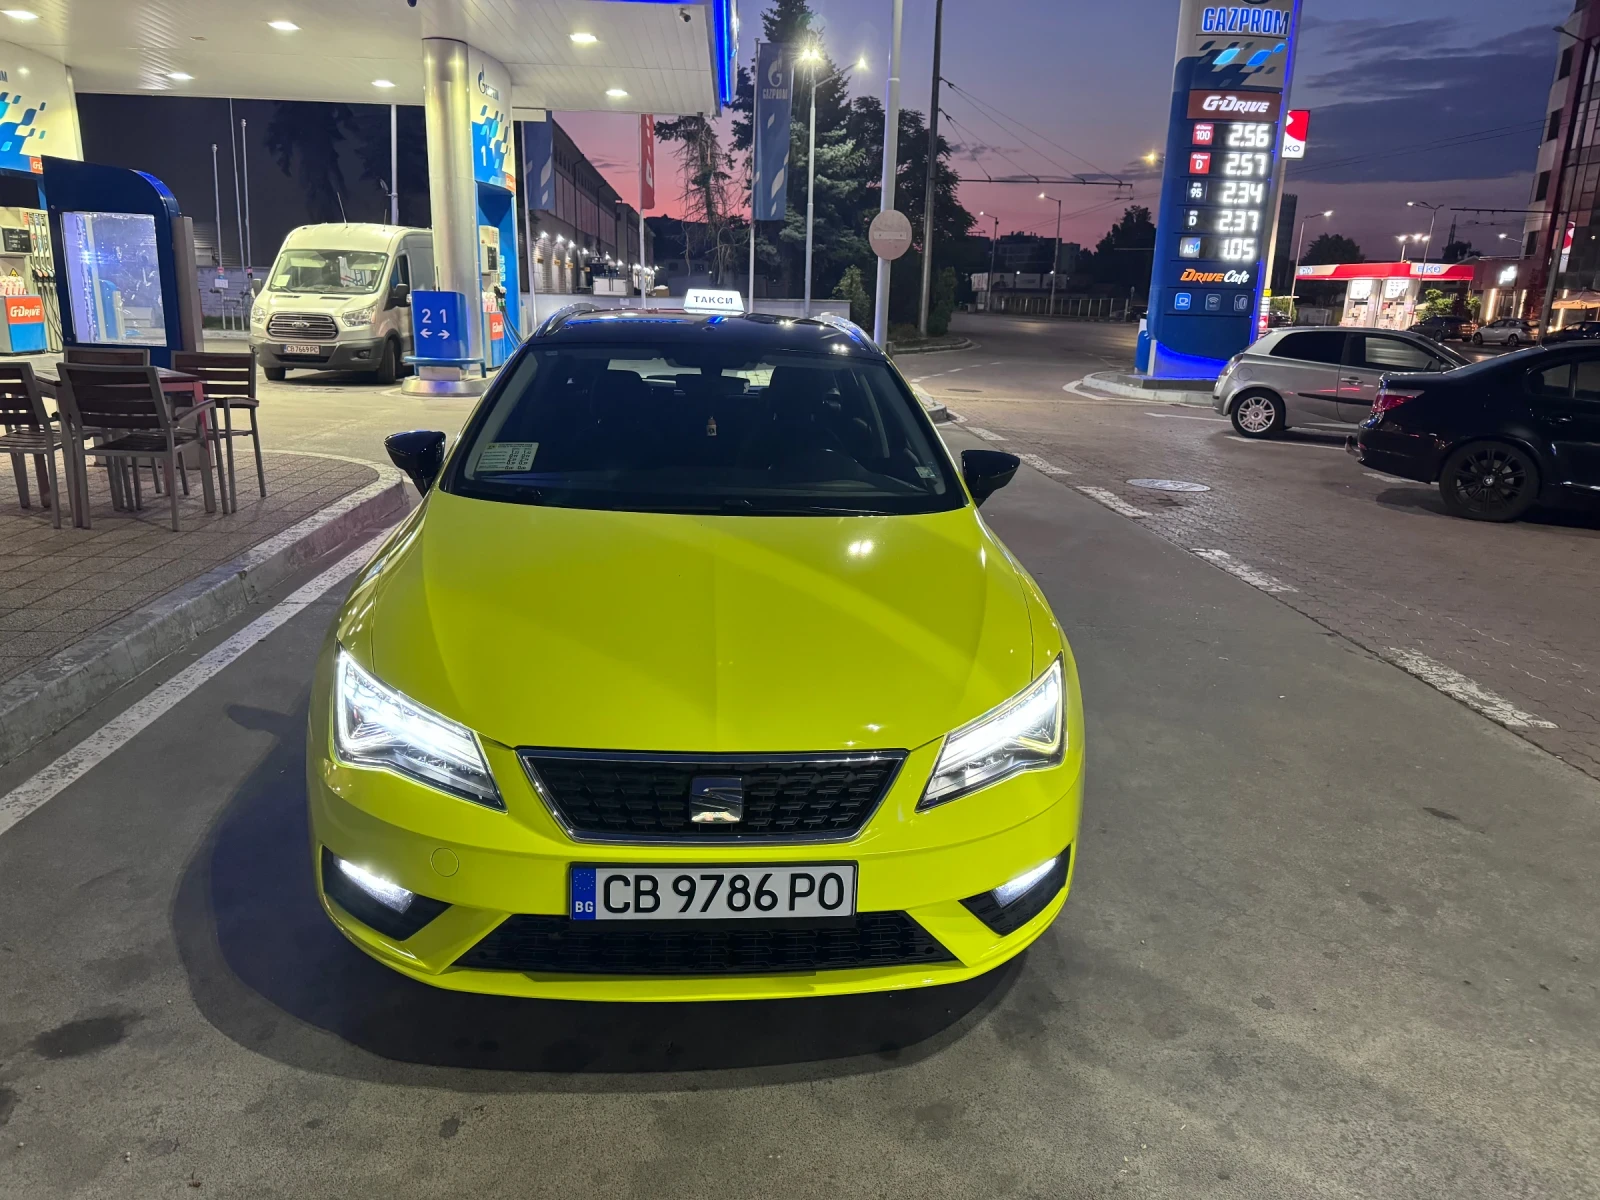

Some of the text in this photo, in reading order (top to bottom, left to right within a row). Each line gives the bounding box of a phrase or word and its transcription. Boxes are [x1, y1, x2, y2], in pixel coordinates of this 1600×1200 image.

[1202, 7, 1290, 35] GAZPROM
[1196, 124, 1269, 147] 100 2.56
[481, 145, 487, 167] 1
[1195, 153, 1266, 176] D 2.57
[1190, 182, 1263, 204] 95 2.34
[1188, 211, 1258, 231] D 2.37
[693, 295, 733, 305] ТАКСИ
[421, 308, 447, 324] 2 1
[603, 874, 661, 914] CB
[672, 873, 779, 913] 9786
[575, 901, 594, 913] BG
